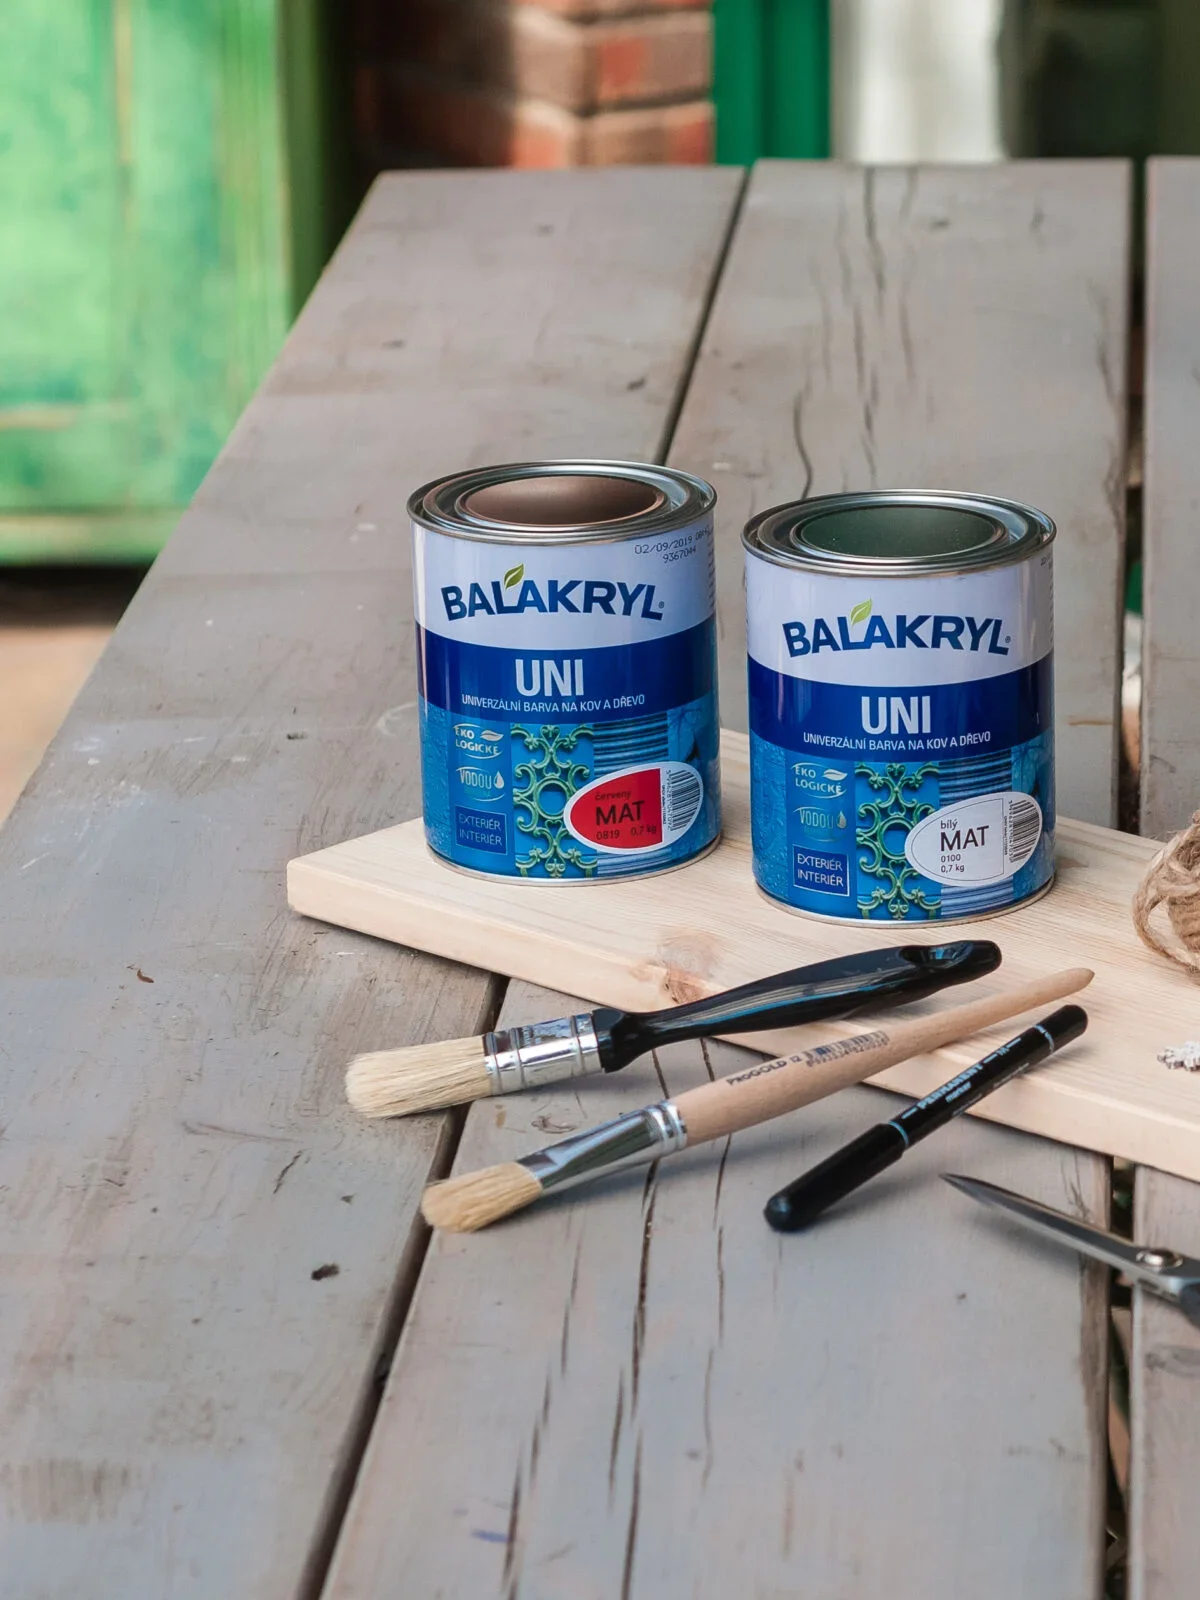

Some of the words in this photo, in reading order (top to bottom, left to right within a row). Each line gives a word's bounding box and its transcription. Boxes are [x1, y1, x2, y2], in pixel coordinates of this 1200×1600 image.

[634, 535, 693, 554] 02/09/2019
[441, 579, 663, 621] BALAKRYL
[782, 614, 1009, 658] BALAKRYL
[515, 659, 585, 697] UNI
[461, 693, 521, 712] UNIVERZÁLNÍ
[523, 701, 560, 713] BARVA
[561, 702, 578, 713] NA
[580, 699, 602, 712] KOV
[603, 698, 611, 710] A
[613, 694, 645, 708] DŘEVO
[861, 695, 931, 735] UNI
[454, 727, 475, 740] EKO
[803, 731, 866, 750] UNIVERZÁLNÍ
[869, 739, 905, 751] BARVA
[908, 739, 925, 751] NA
[926, 737, 948, 750] KOV
[949, 736, 958, 748] A
[959, 730, 991, 747] DŘEVO
[794, 765, 816, 779] EKO
[458, 813, 502, 832] EXTERIÉR
[595, 800, 645, 826] MAT
[940, 818, 958, 831] bílý
[459, 828, 503, 847] INTERIÉR
[596, 829, 620, 840] 0819
[940, 825, 990, 852] MAT
[797, 853, 843, 871] EXTERIÉR
[940, 853, 961, 863] 0100
[797, 869, 844, 887] INTERIÉR
[940, 864, 953, 874] 0,7
[955, 863, 965, 873] kg
[916, 1063, 983, 1109] PERMANENT
